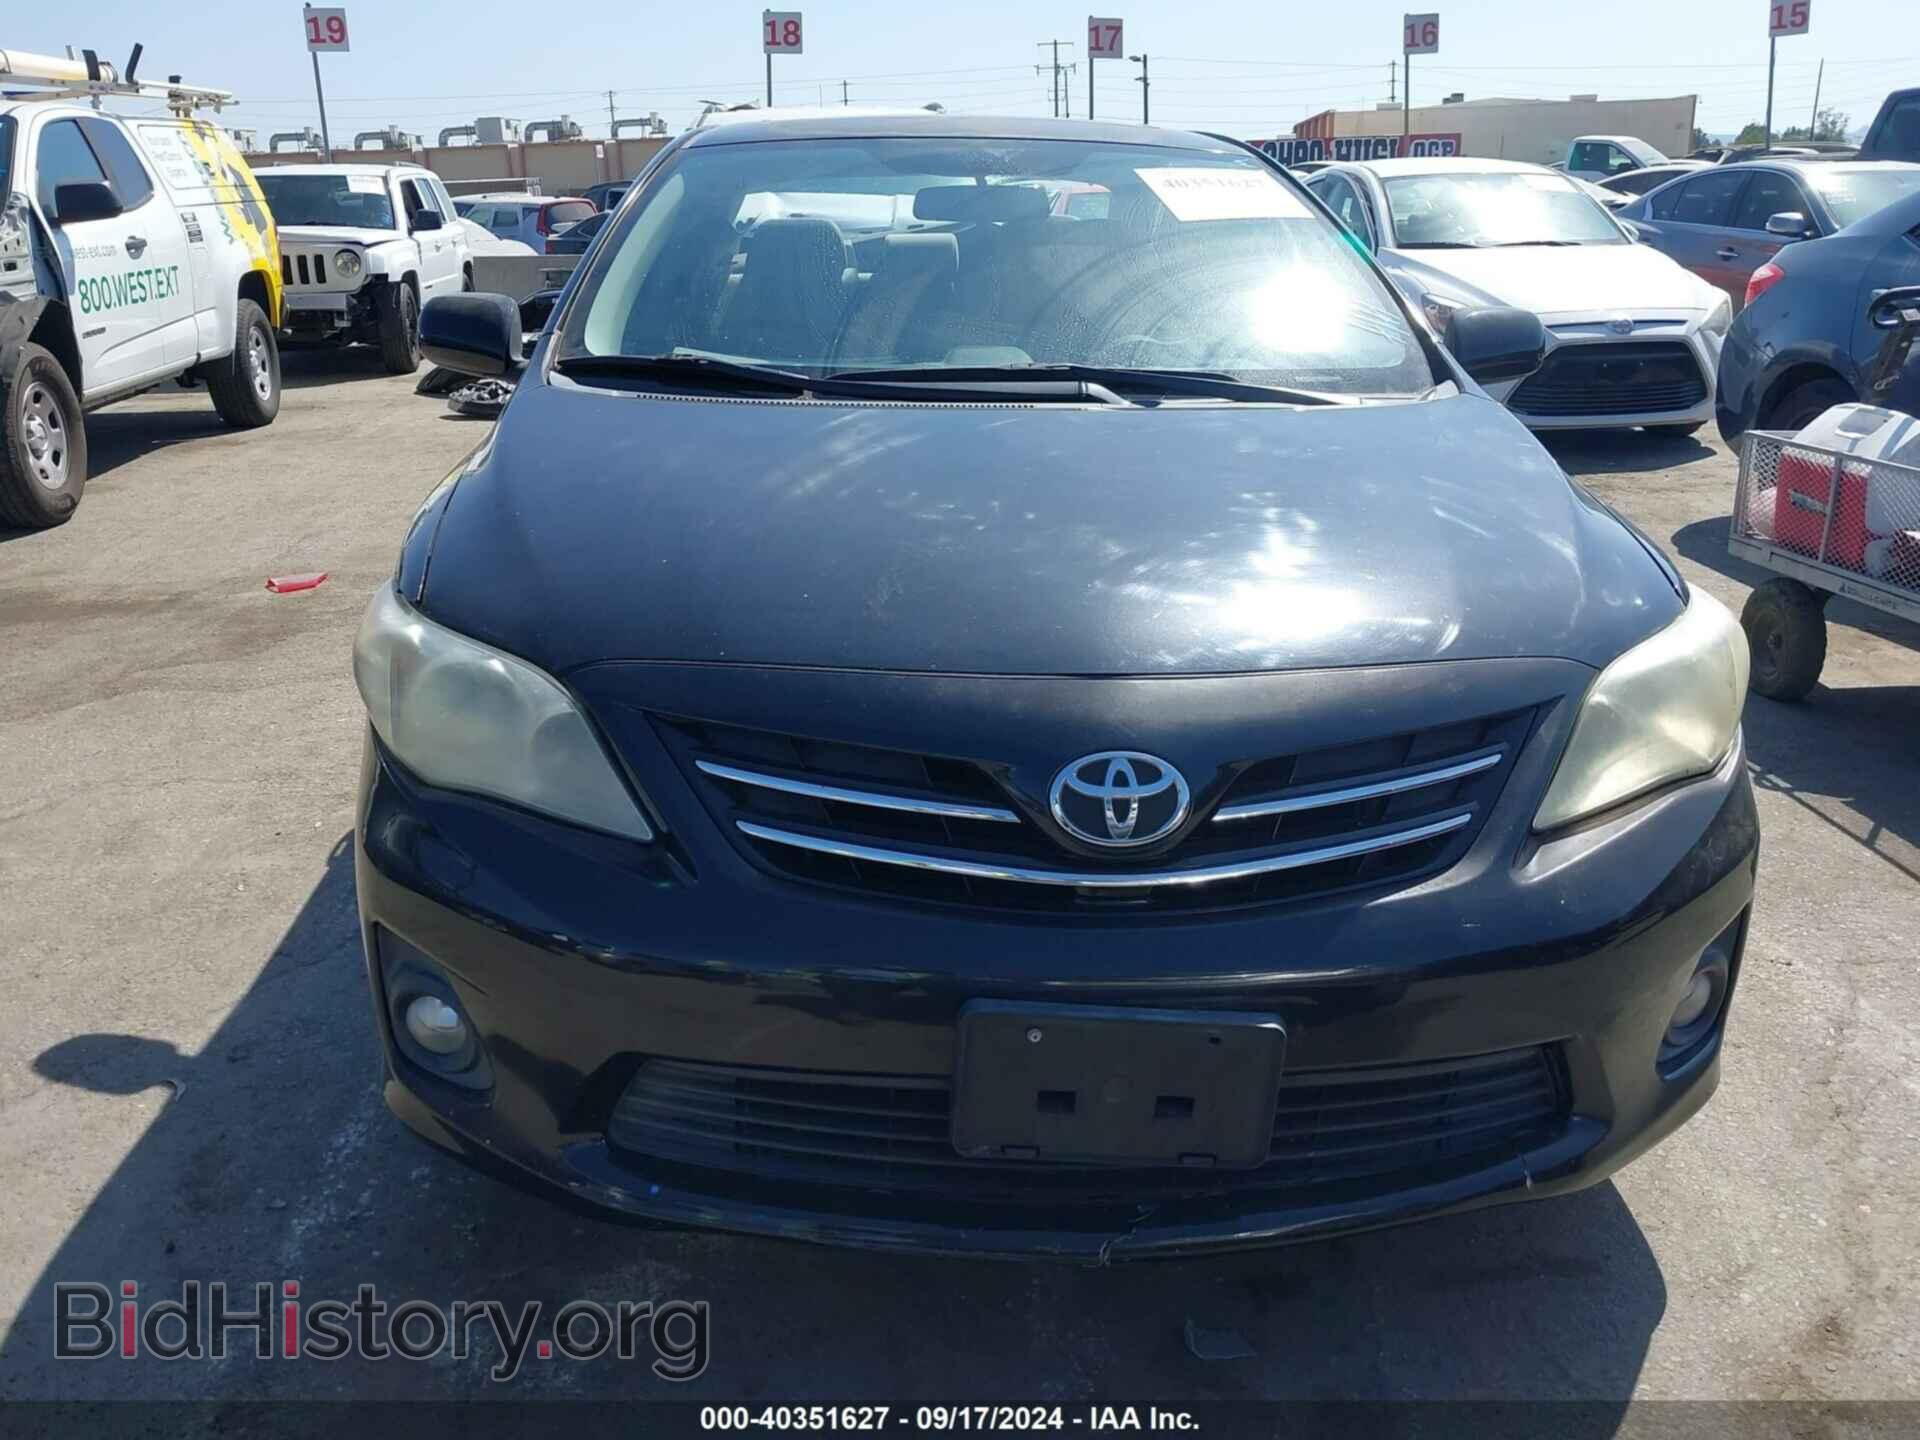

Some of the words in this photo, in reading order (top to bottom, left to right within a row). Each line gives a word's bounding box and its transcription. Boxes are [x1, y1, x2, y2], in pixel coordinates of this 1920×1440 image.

[1770, 2, 1808, 29] 15
[307, 16, 346, 44] 19
[766, 20, 800, 46] 18
[1089, 25, 1121, 51] 17
[1405, 22, 1439, 48] 16
[78, 265, 180, 314] 800.WEST.EXT
